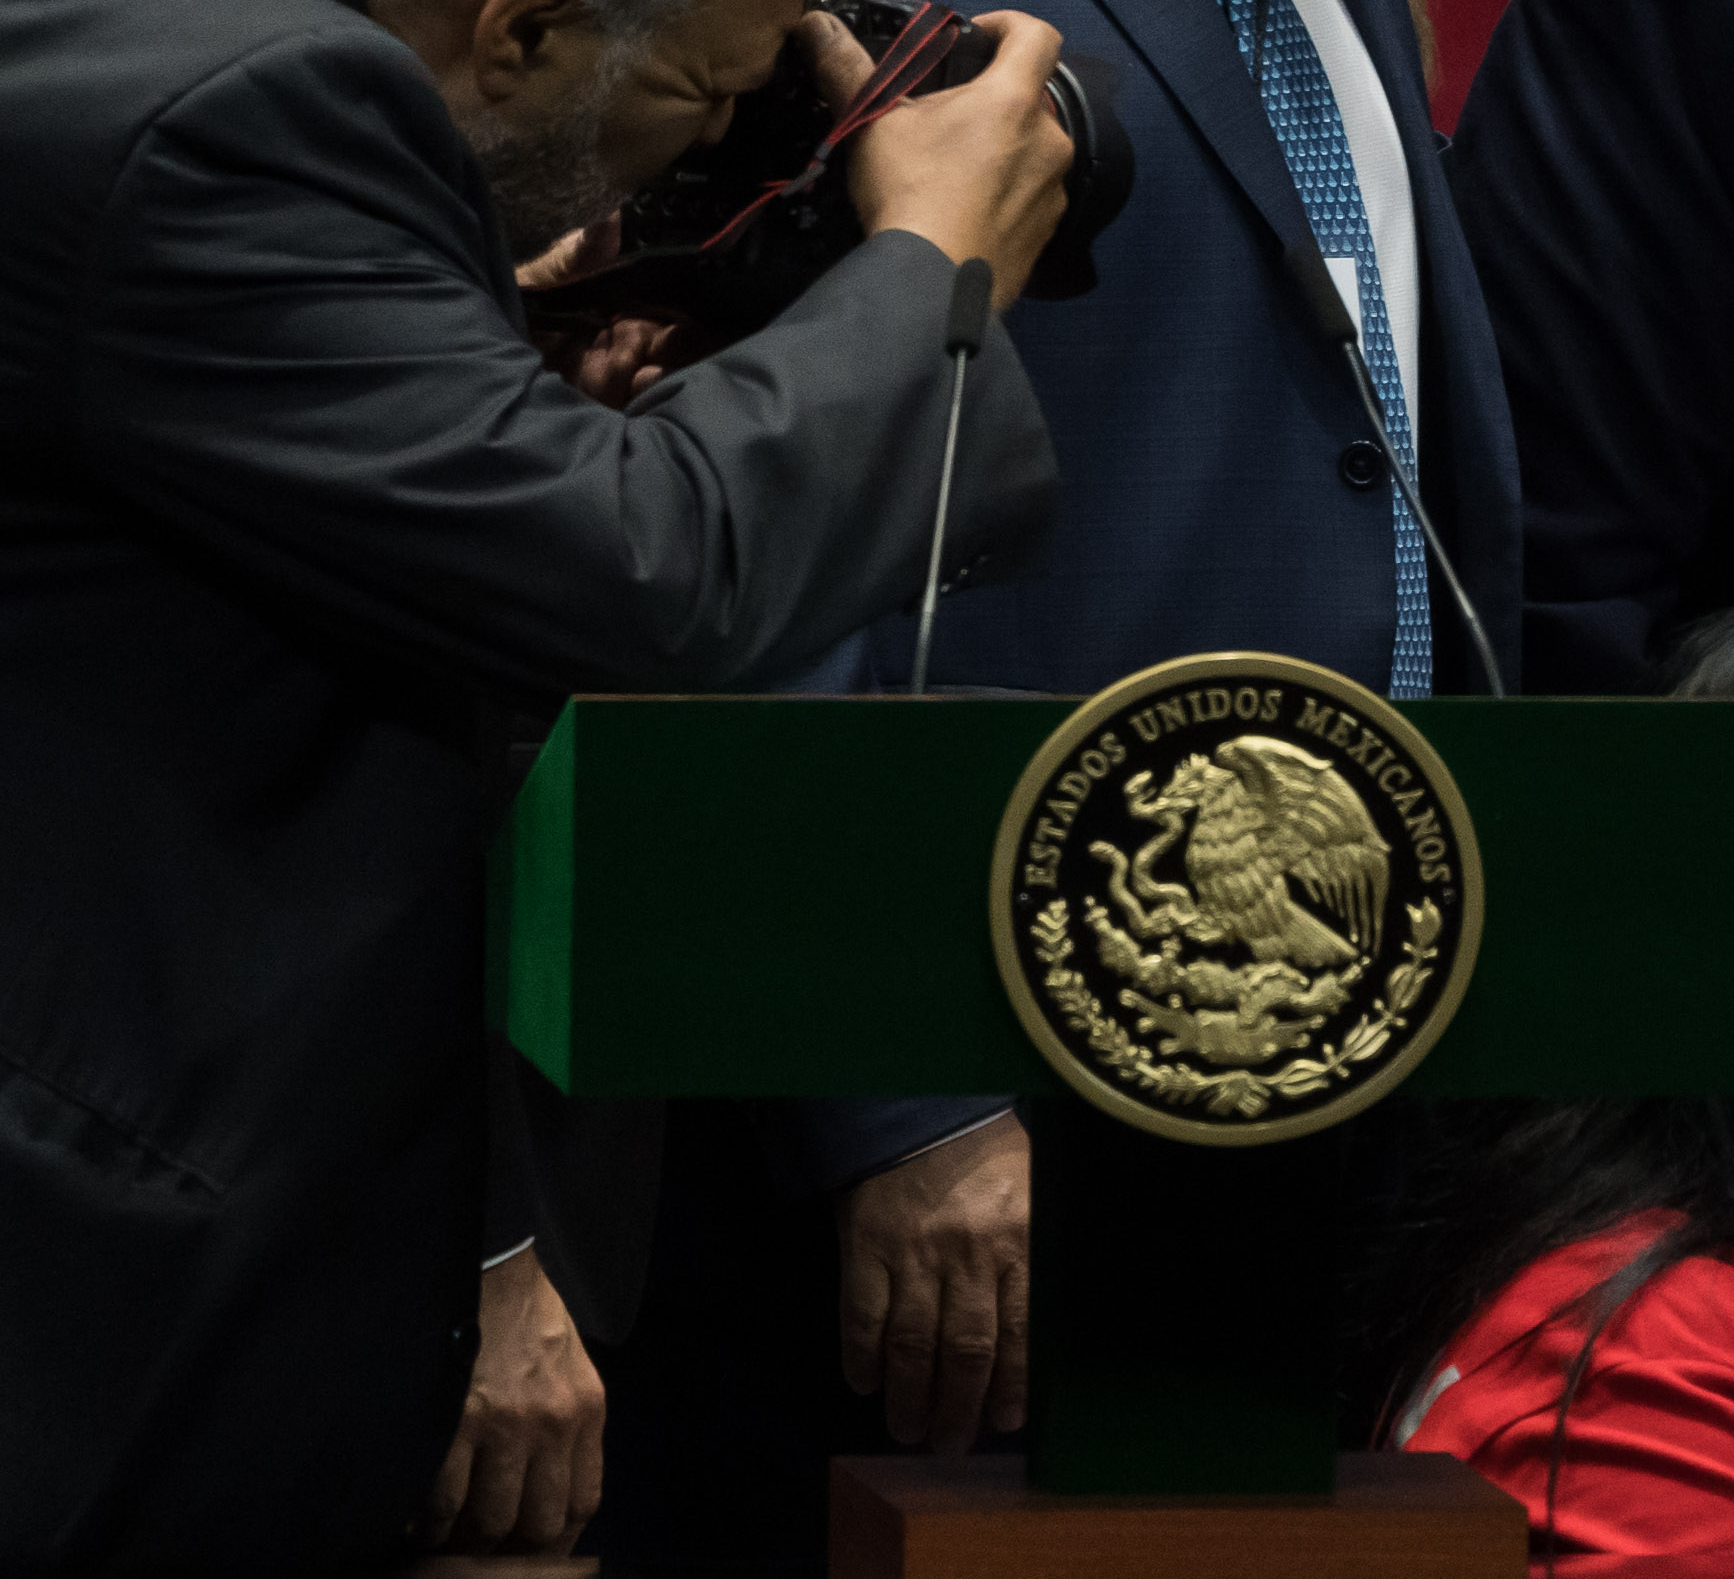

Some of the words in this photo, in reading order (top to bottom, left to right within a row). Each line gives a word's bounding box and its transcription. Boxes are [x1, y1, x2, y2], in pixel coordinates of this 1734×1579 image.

[1024, 731, 1127, 888] ESTADOS
[1129, 687, 1284, 742] UNIDOS
[1296, 697, 1452, 884] MEXICANOS
